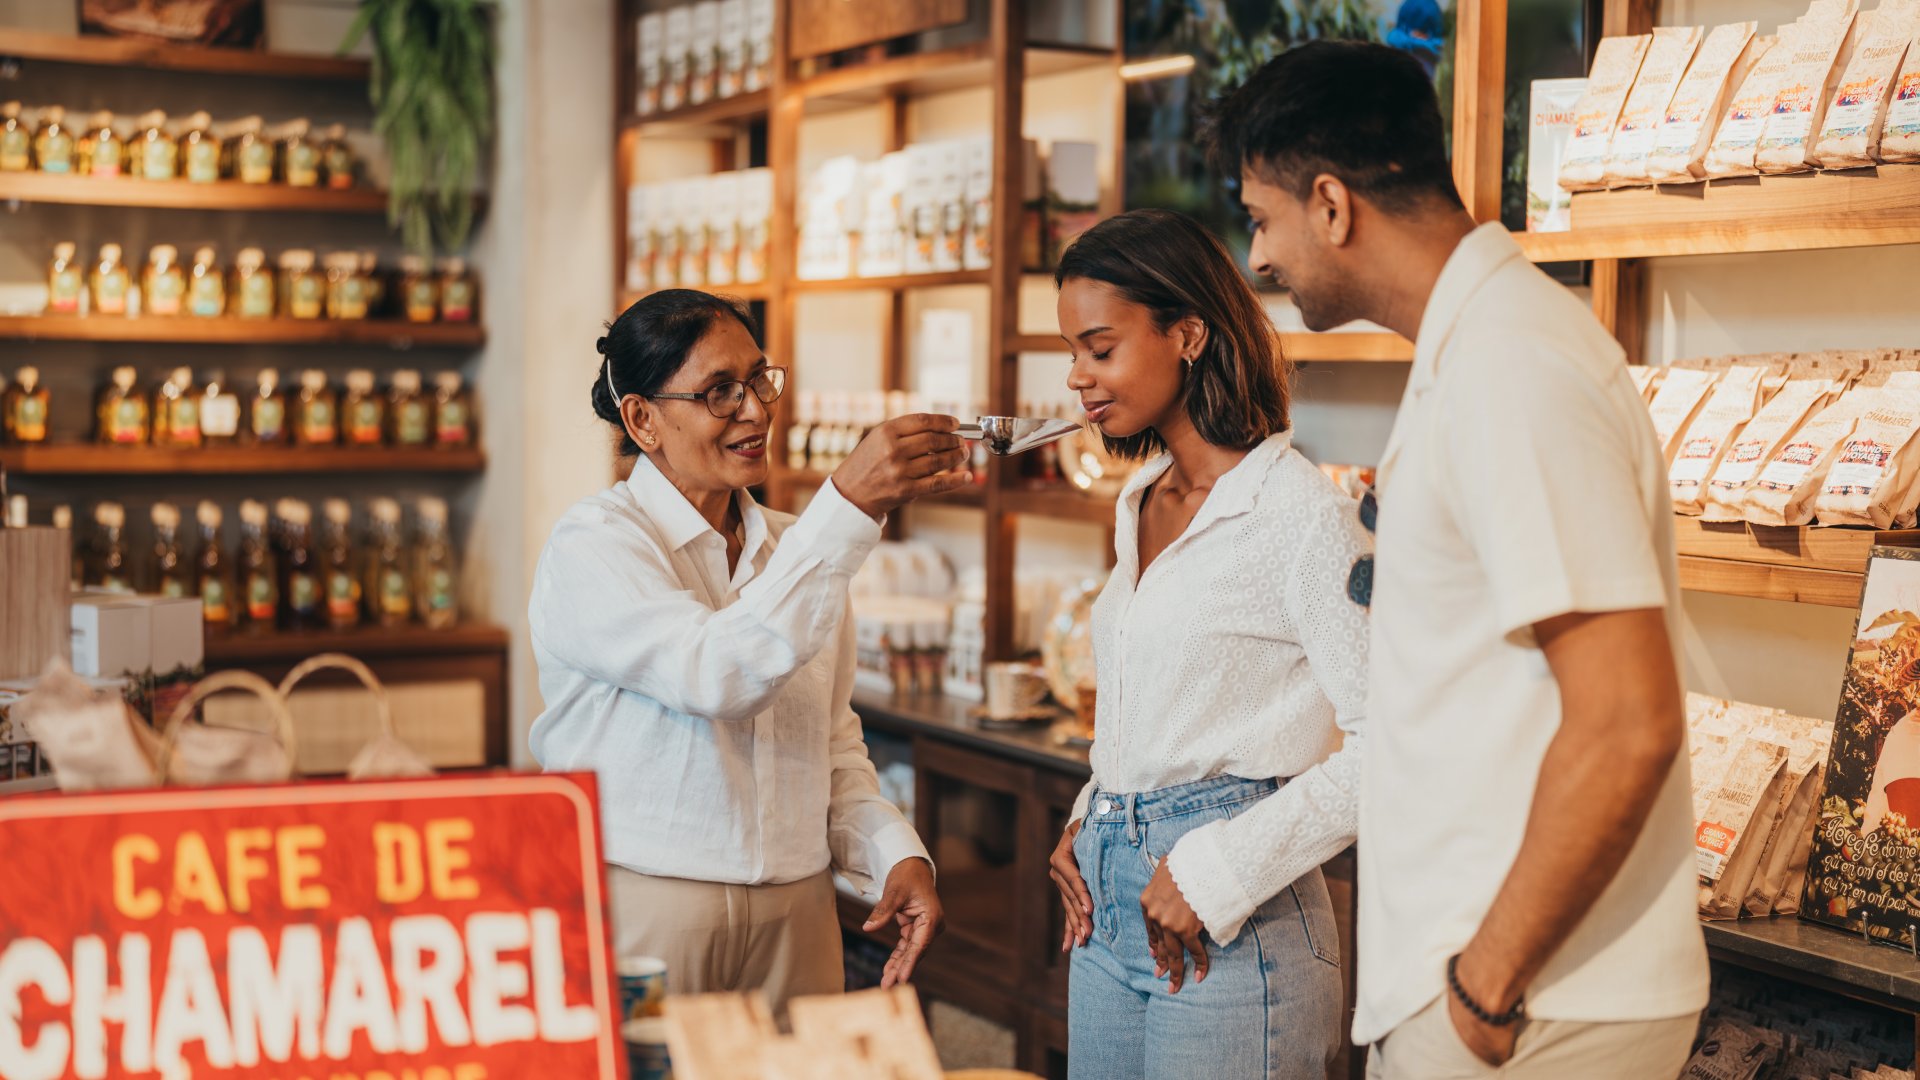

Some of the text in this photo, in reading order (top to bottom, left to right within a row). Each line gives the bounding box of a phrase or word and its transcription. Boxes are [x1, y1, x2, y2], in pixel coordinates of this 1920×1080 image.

[1846, 451, 1881, 462] VOYAGE
[1852, 444, 1882, 454] GRAND
[1717, 787, 1752, 807] CHAMAREL
[1698, 834, 1725, 849] VOYAGE
[1703, 827, 1727, 840] GRAND
[1881, 840, 1917, 859] donne
[112, 818, 480, 919] CAFE DE
[1824, 855, 1840, 872] qui
[1841, 861, 1855, 876] en
[1856, 861, 1879, 880] ont
[1876, 862, 1892, 881] et
[1889, 863, 1909, 883] des
[1823, 876, 1839, 894] qui
[1867, 888, 1891, 908] ont
[1883, 897, 1907, 914] pas
[0, 908, 598, 1080] CHAMAREL
